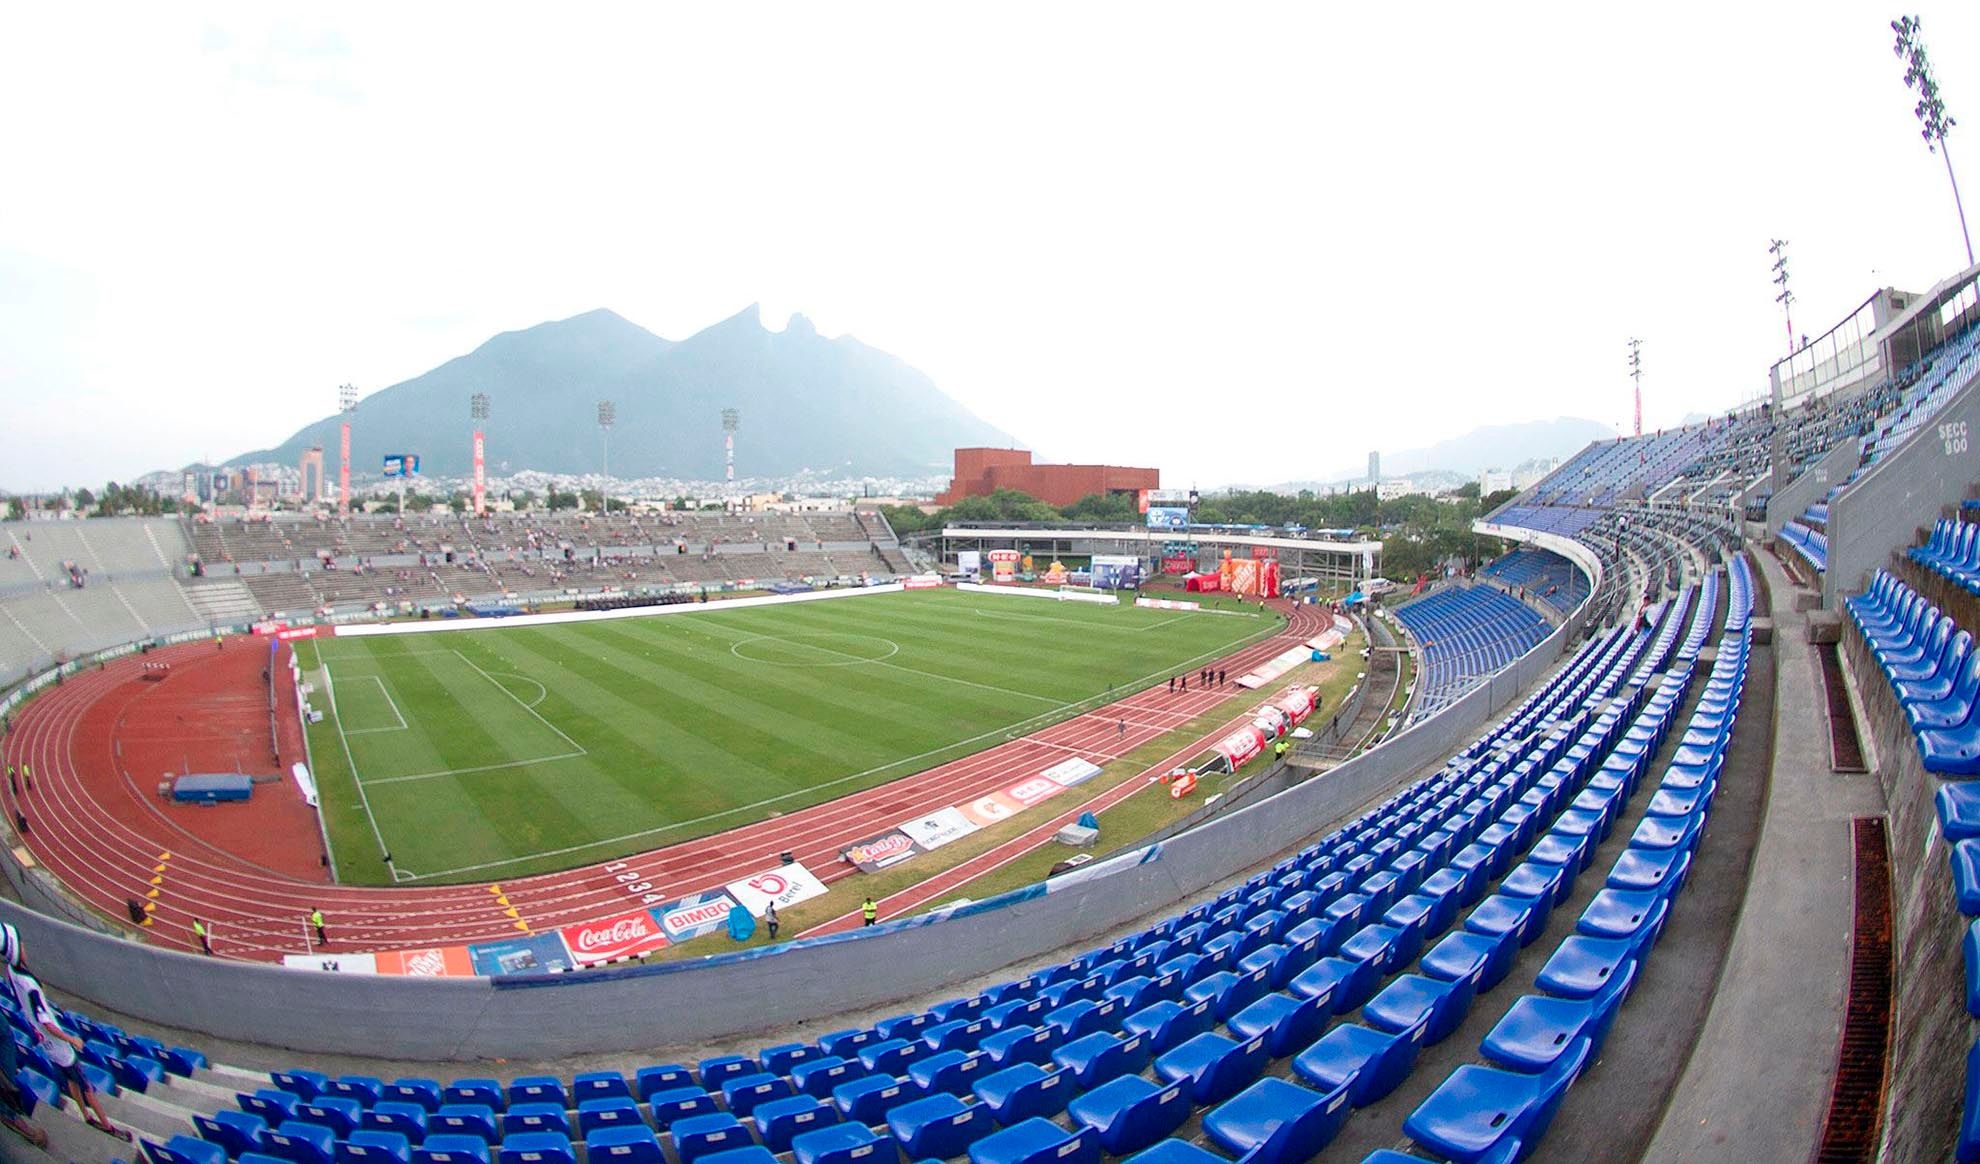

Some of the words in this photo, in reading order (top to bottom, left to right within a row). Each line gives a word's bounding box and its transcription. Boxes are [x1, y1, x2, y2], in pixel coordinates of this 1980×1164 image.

[1938, 421, 1967, 440] SECC
[604, 863, 627, 872] 1
[616, 872, 640, 882] 2
[628, 882, 652, 892] 3
[642, 894, 665, 904] 4
[778, 881, 803, 903] Berel
[668, 902, 731, 928] BIMBO
[578, 917, 647, 950] Coca-Cola
